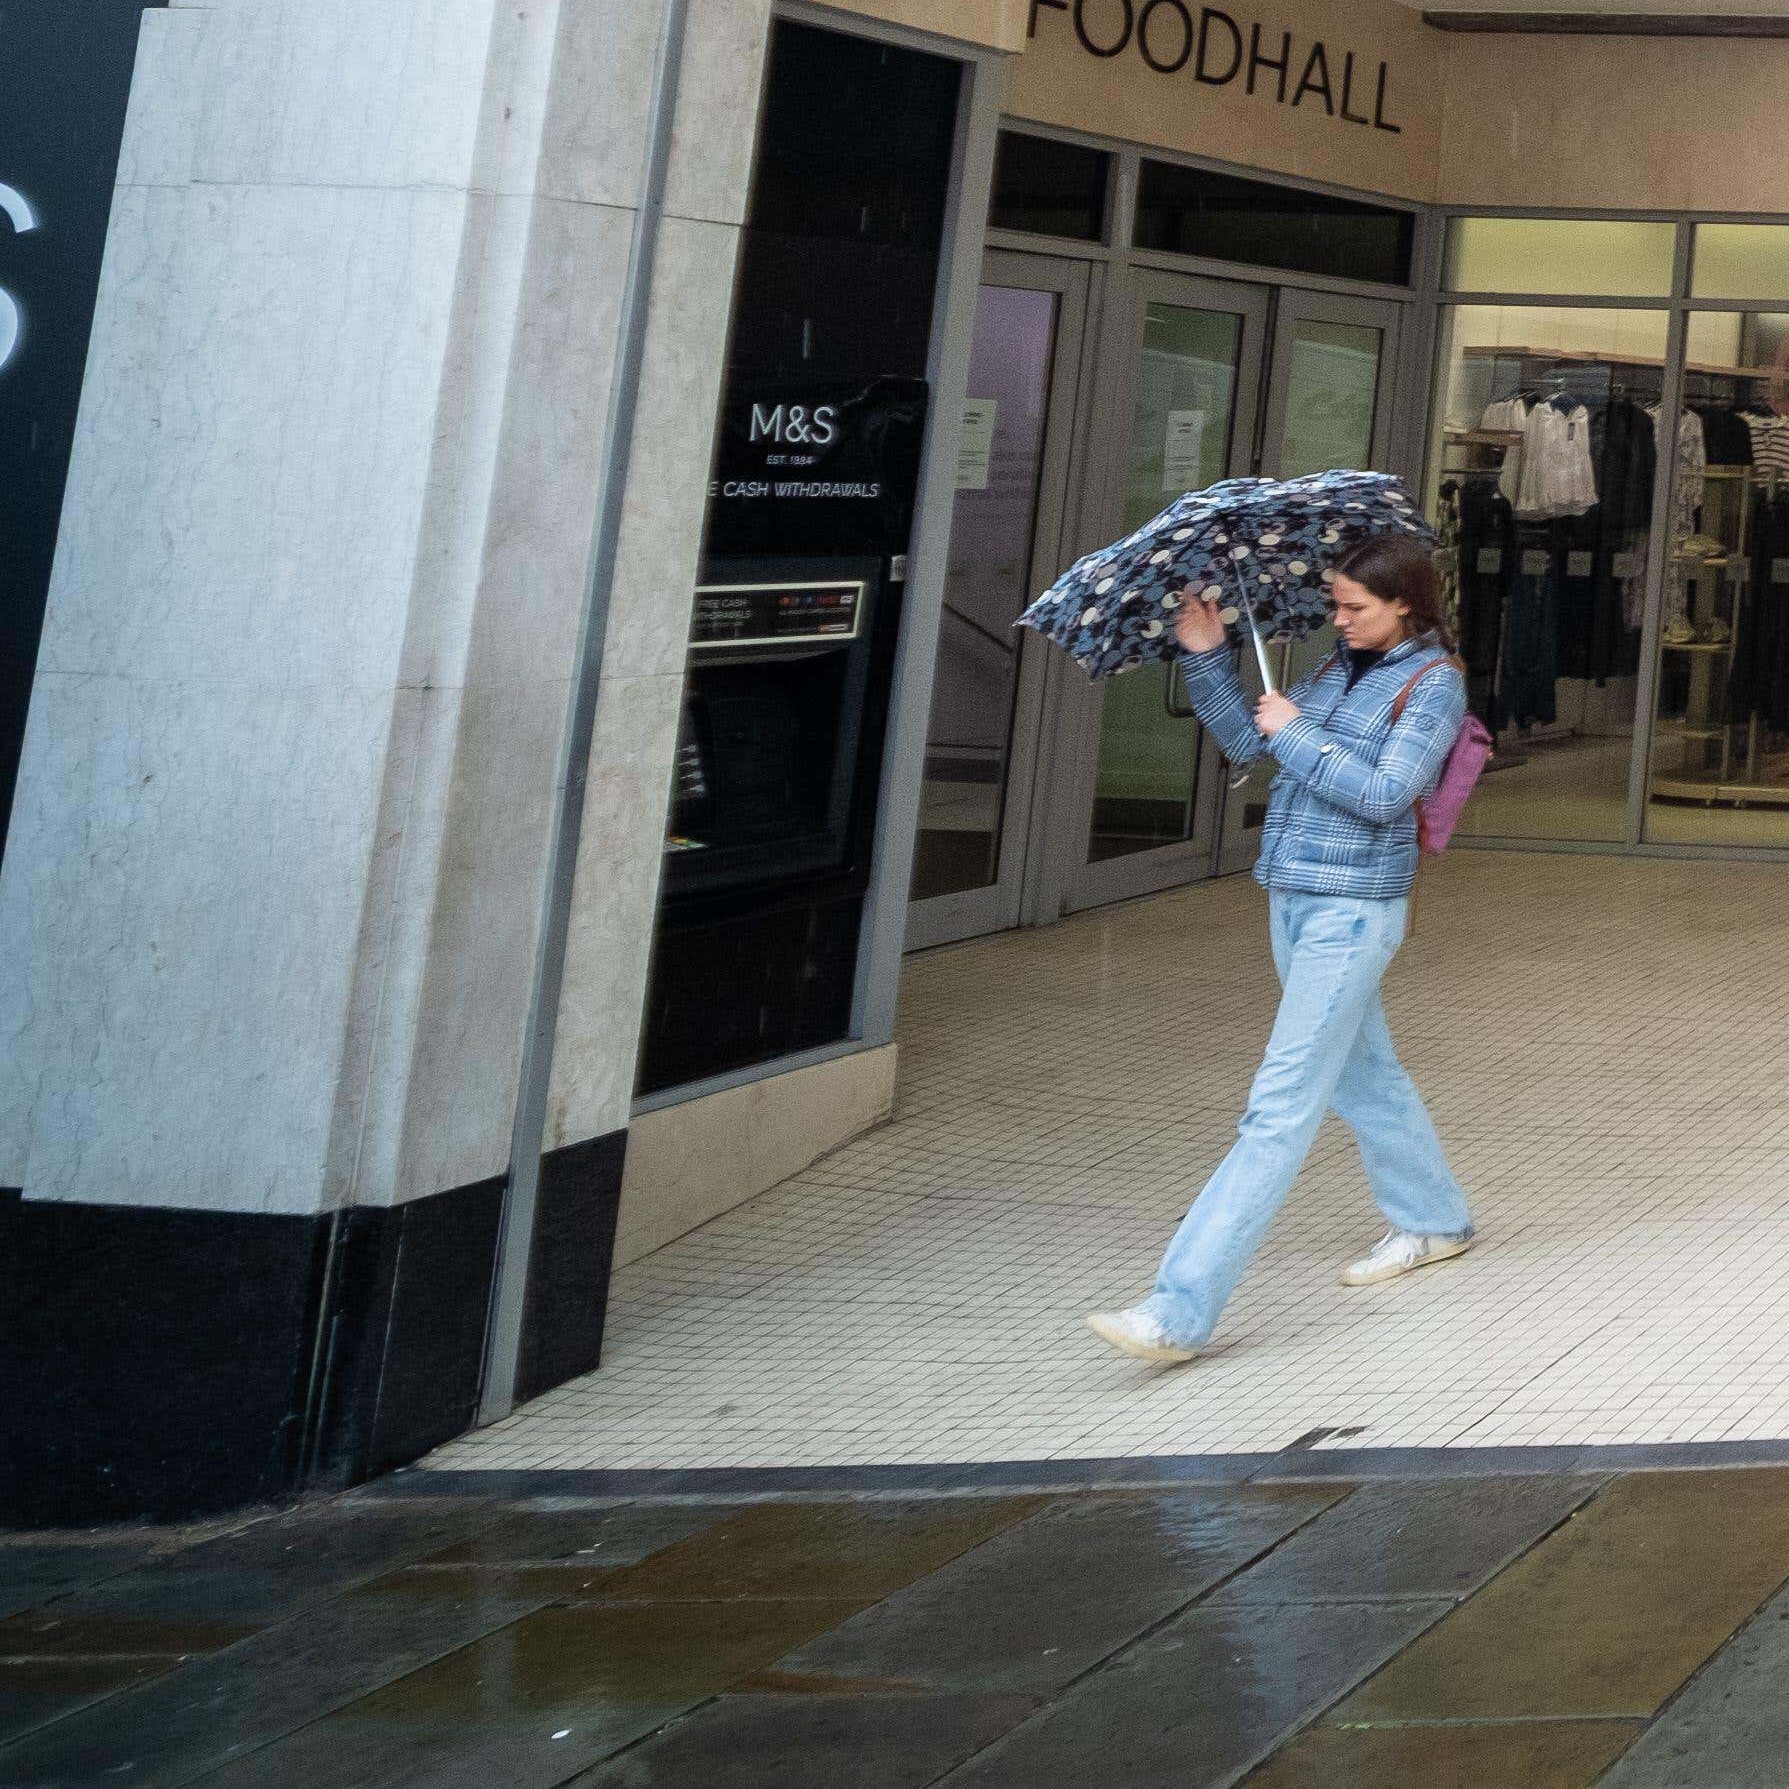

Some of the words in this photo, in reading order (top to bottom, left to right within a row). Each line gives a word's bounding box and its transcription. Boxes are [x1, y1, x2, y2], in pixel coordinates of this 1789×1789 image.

[749, 403, 836, 444] M&S
[723, 481, 769, 497] CASH
[774, 482, 881, 498] WITHDRAWALS
